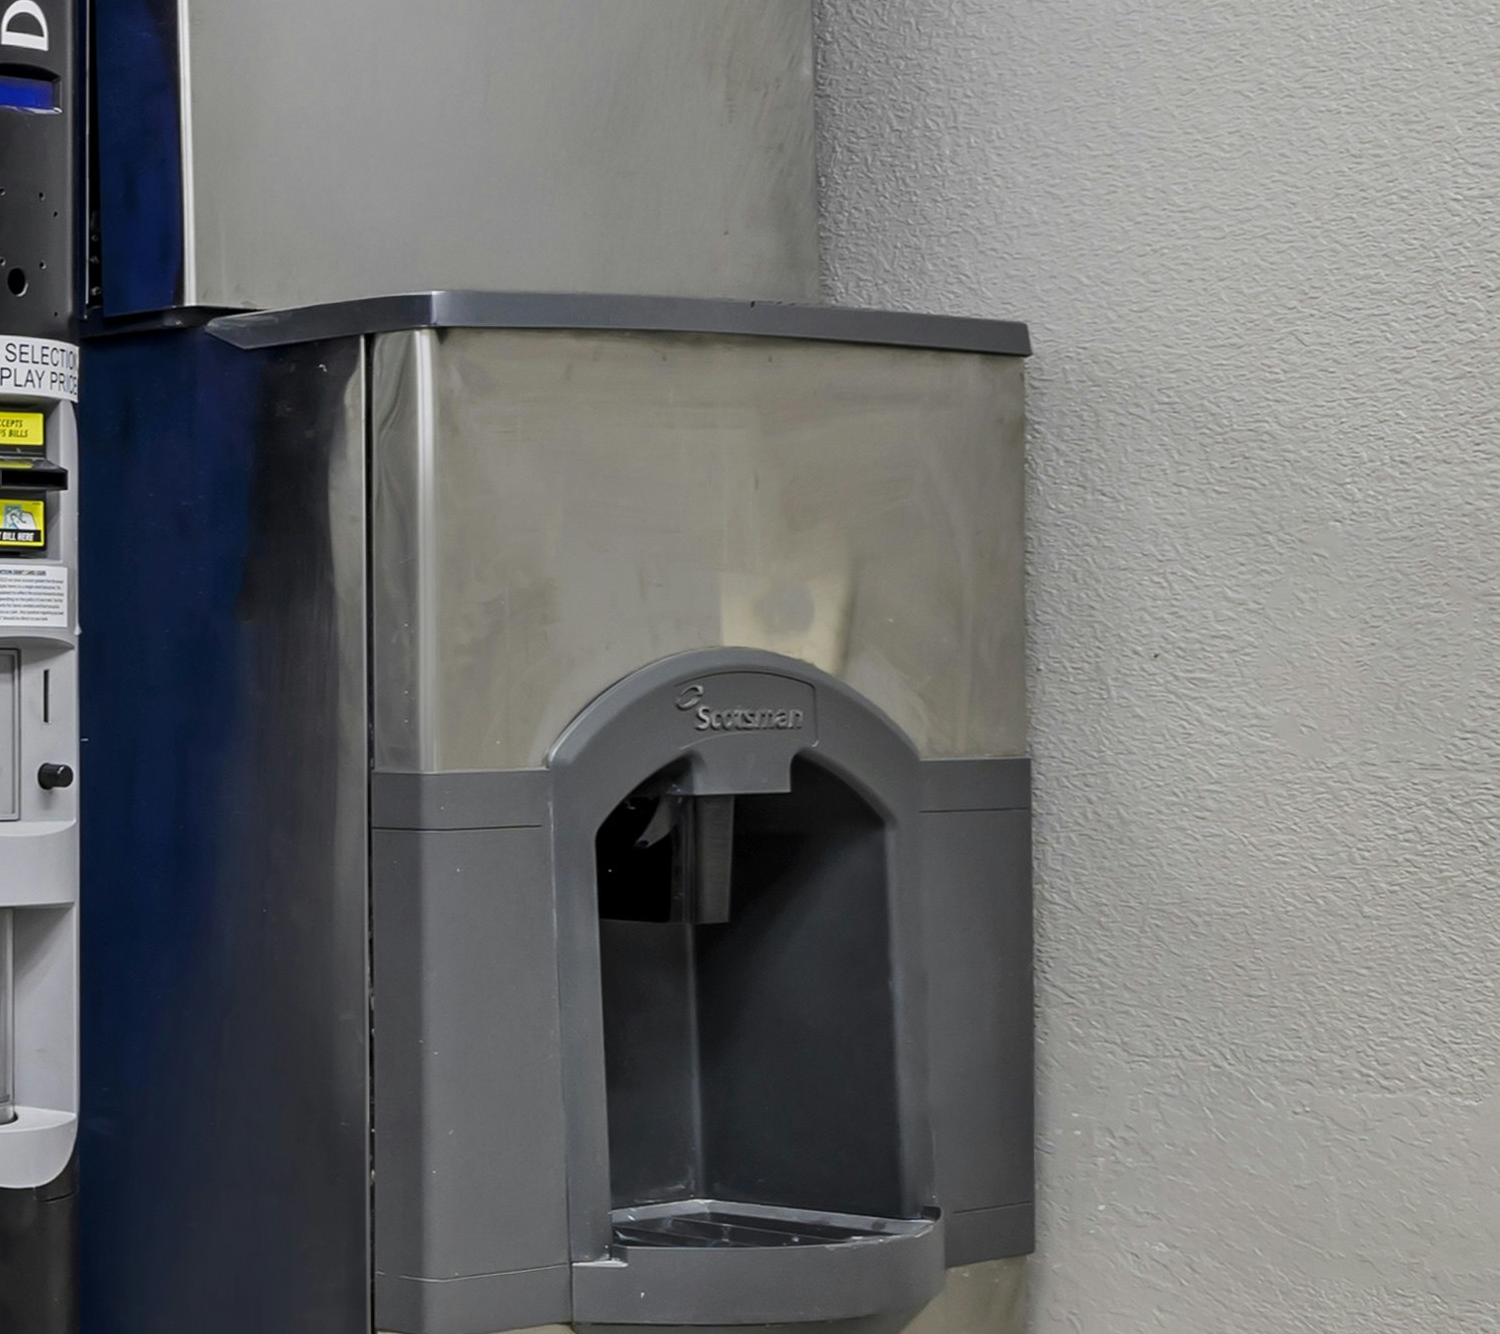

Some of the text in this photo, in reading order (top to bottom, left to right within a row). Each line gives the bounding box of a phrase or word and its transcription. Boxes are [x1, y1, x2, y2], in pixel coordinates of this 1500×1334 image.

[5, 343, 76, 371] SELECTIO
[50, 372, 78, 396] PRICE
[694, 705, 804, 731] Scotsman
